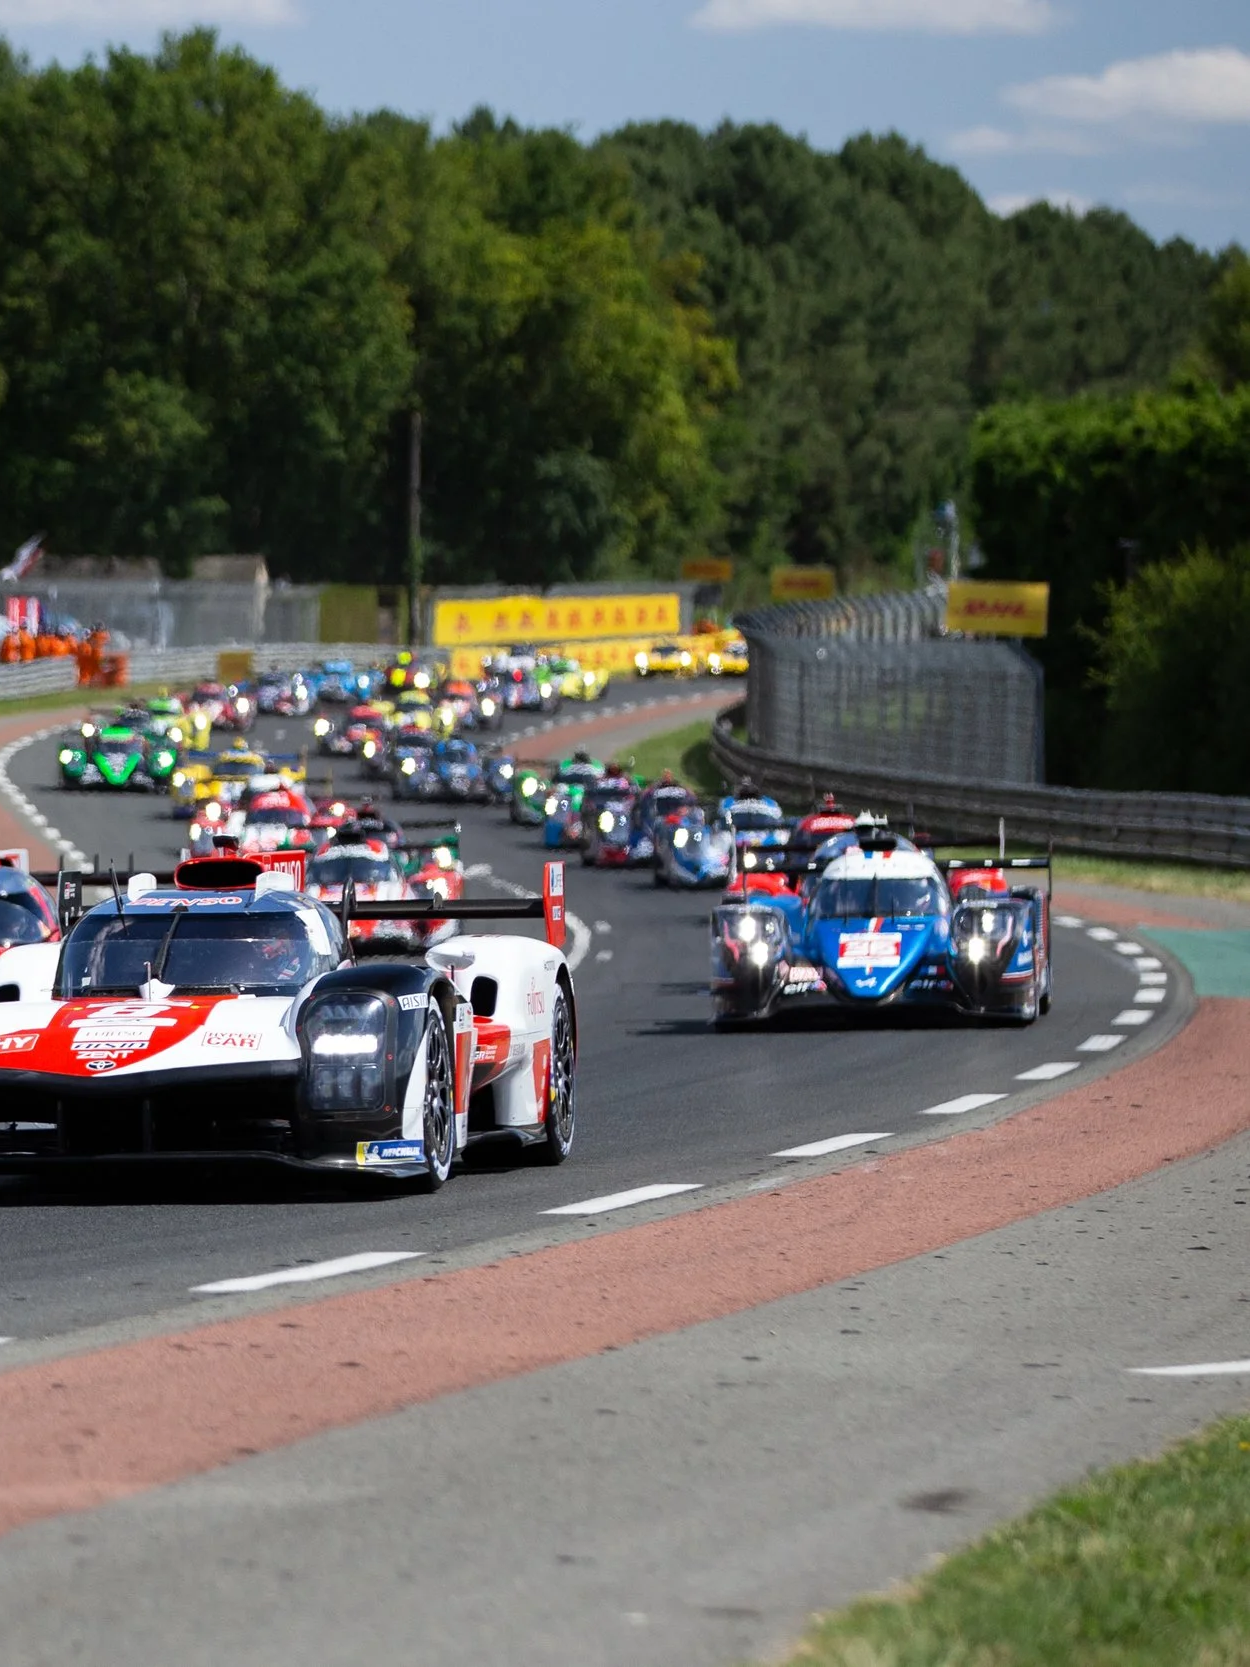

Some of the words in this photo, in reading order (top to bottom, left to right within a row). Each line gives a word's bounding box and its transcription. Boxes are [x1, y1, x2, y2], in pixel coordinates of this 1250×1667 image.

[127, 896, 243, 907] DENSO
[402, 994, 427, 1008] AISIN
[207, 1037, 254, 1047] CAR
[76, 1050, 135, 1059] ZENT
[382, 1147, 421, 1157] MICHELIN
